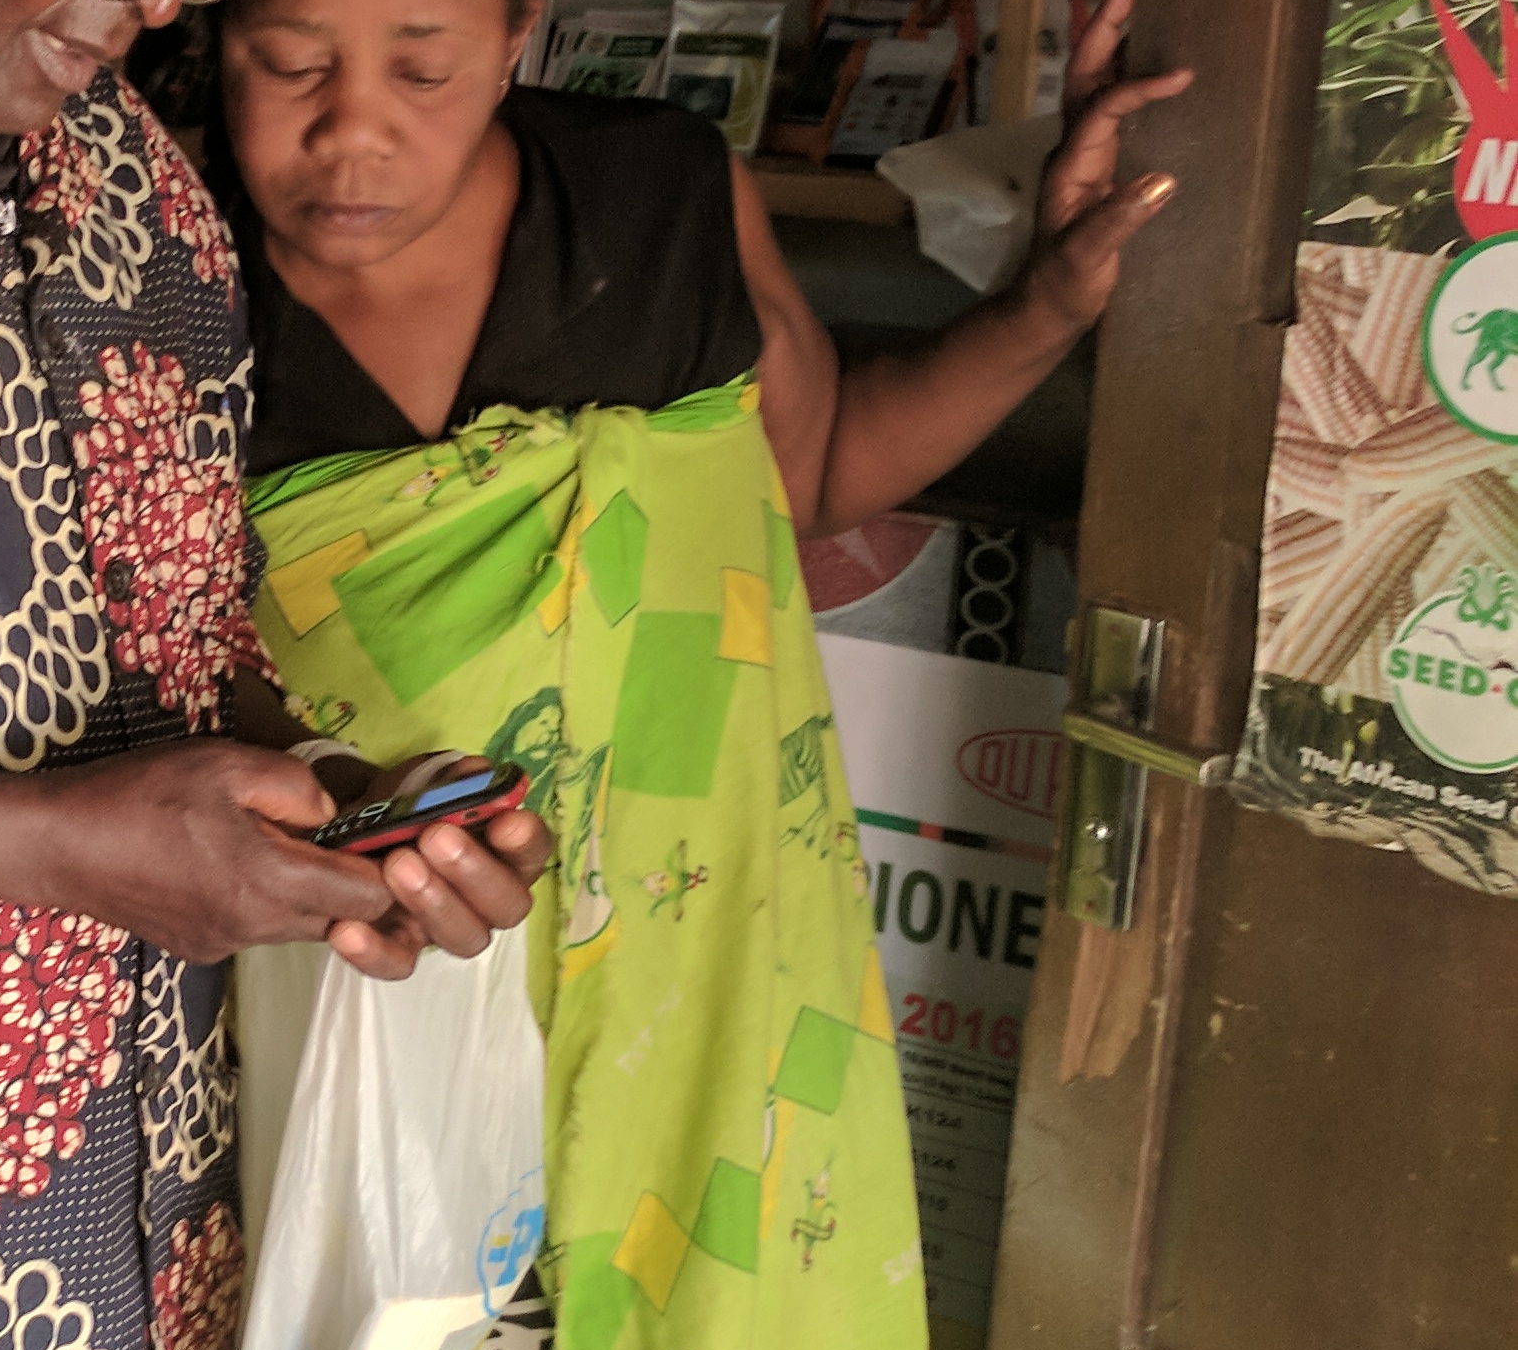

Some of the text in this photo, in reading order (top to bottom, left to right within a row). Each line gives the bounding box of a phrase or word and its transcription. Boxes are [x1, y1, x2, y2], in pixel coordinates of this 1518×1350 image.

[1461, 138, 1518, 207] N
[1298, 746, 1343, 776] The
[1348, 759, 1436, 802] African
[1439, 784, 1509, 821] Seed
[864, 861, 1046, 970] IONE
[899, 992, 1021, 1060] 2016
